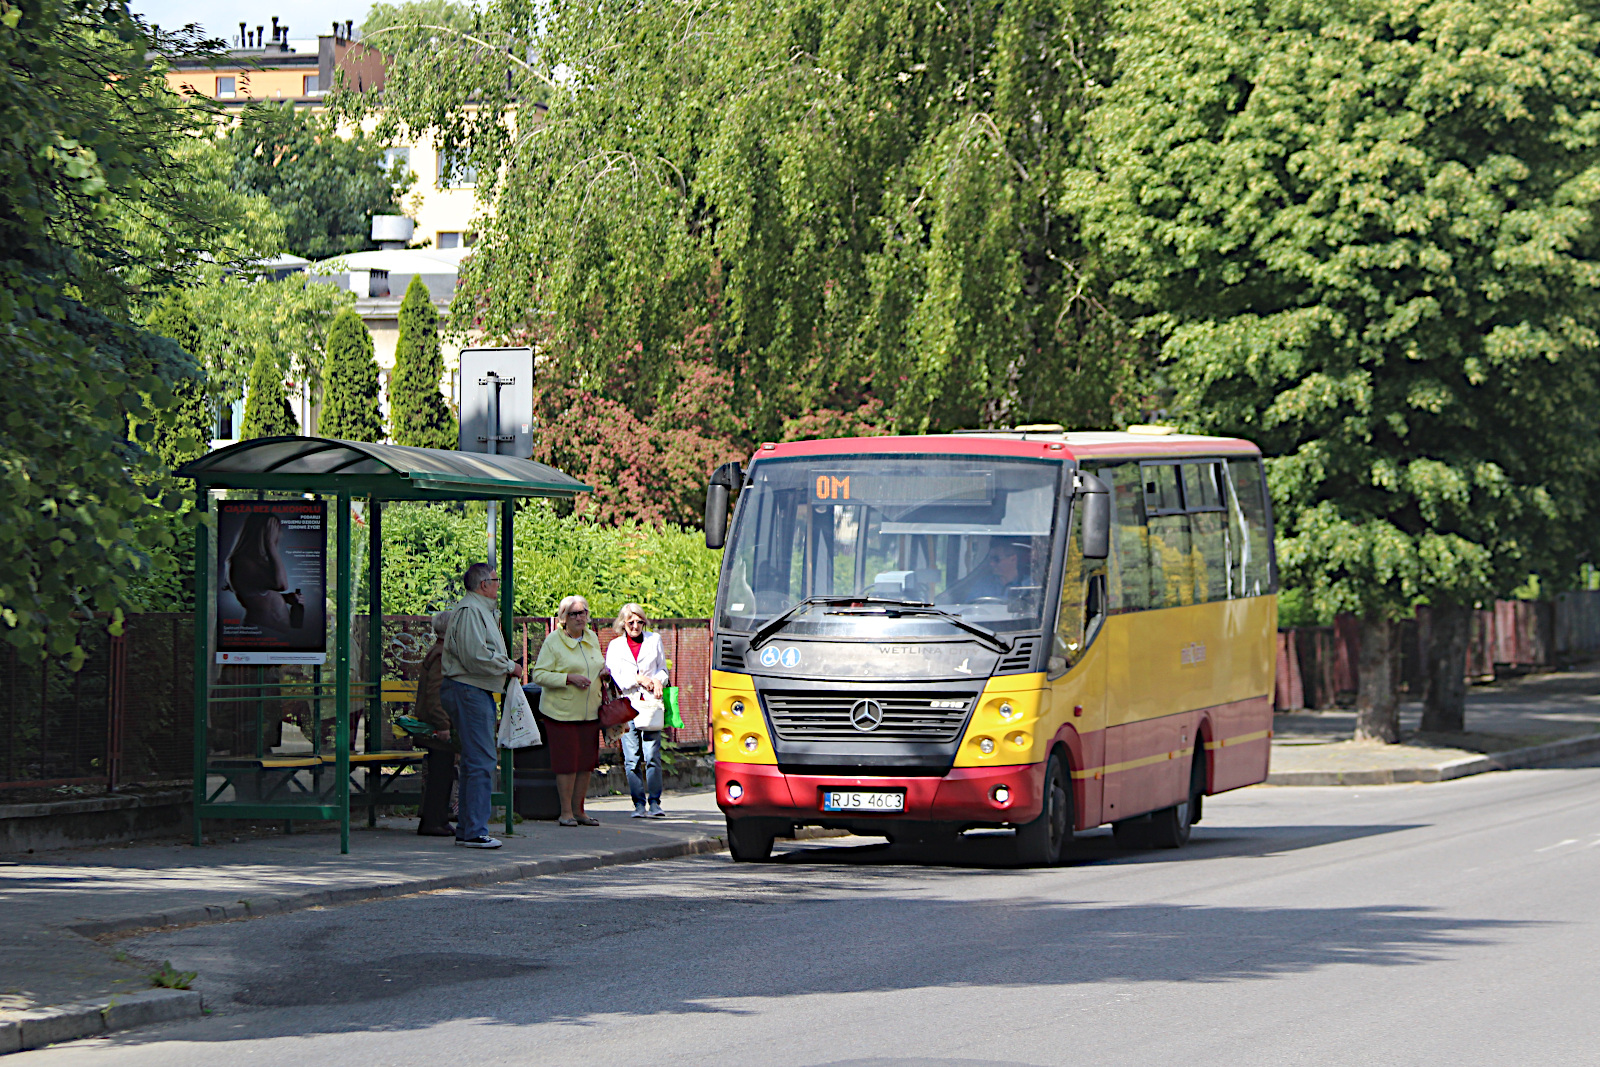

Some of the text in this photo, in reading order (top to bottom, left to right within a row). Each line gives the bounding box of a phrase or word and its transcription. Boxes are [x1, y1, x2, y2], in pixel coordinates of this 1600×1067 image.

[224, 504, 321, 515] CIĄŻA BEZ ALKOHOLU
[880, 647, 943, 655] WETLINA
[832, 793, 902, 808] RJS 46C3
